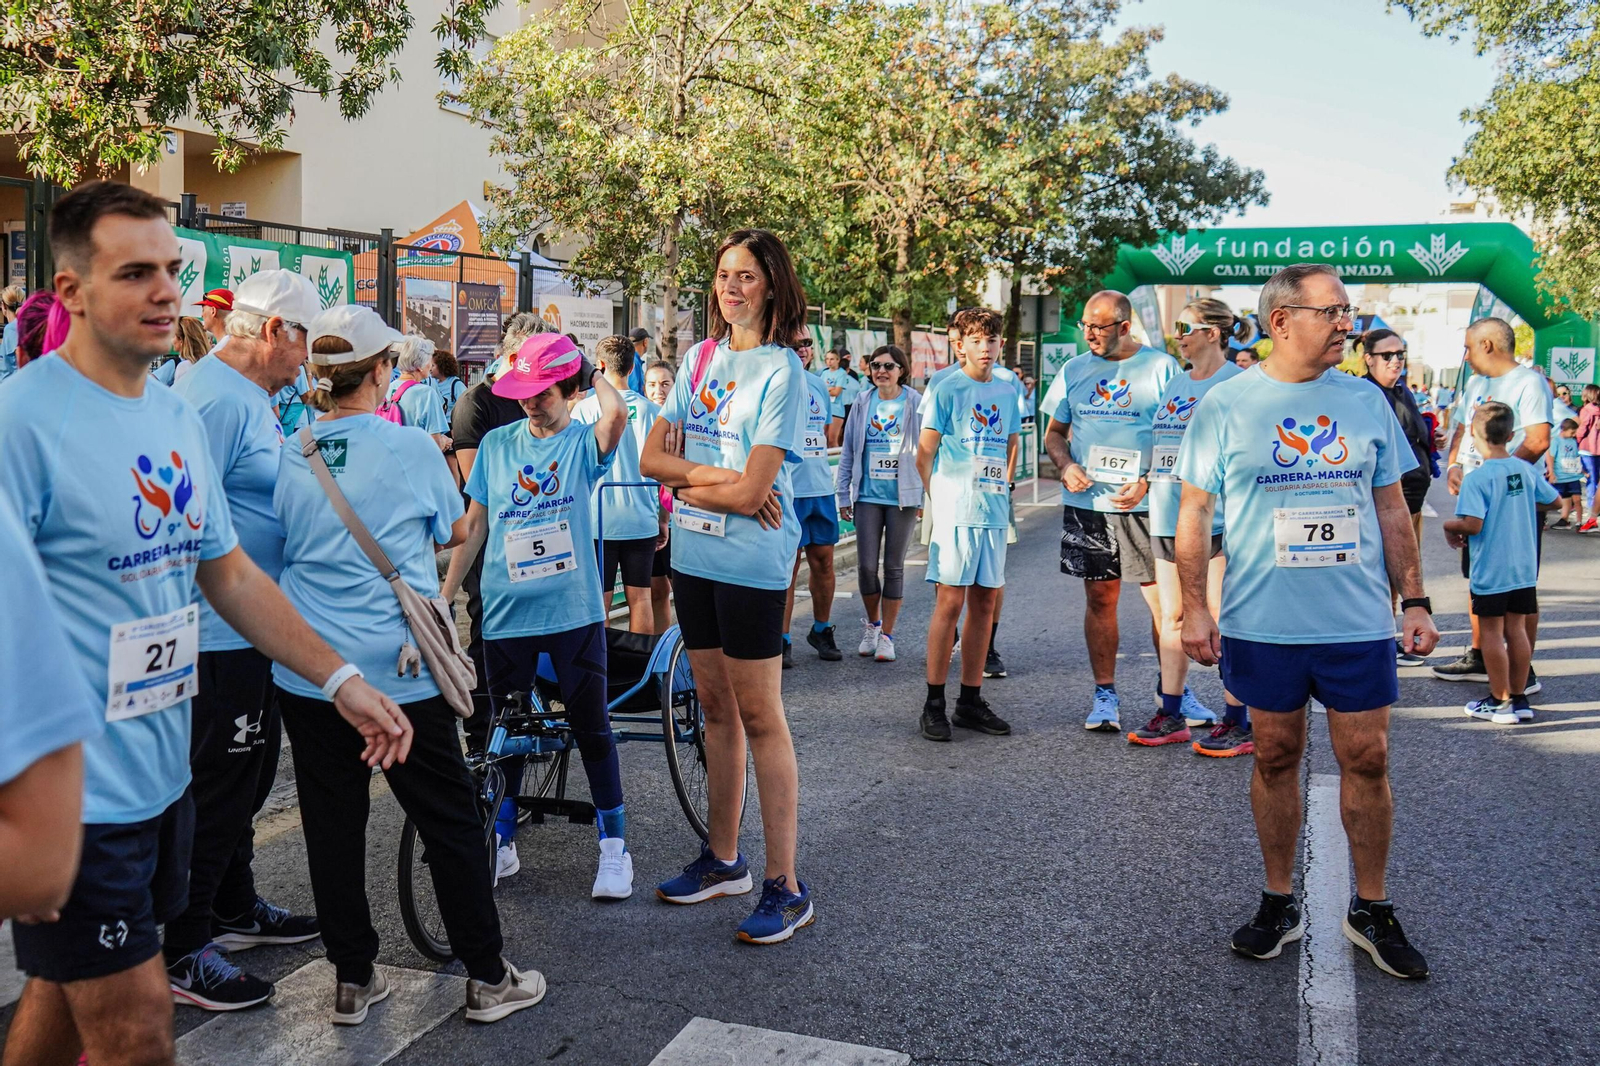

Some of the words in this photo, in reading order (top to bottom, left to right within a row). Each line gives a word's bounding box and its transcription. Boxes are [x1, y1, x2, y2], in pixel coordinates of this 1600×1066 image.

[1214, 236, 1396, 258] fundación
[221, 247, 231, 287] ación
[1213, 264, 1251, 276] CAJA
[1254, 264, 1283, 276] RUR
[1339, 264, 1394, 276] ANADA
[468, 297, 498, 311] OMEGA
[570, 320, 590, 328] HACEMOS
[596, 320, 608, 329] SUEÑO
[878, 459, 899, 469] 192
[1101, 456, 1128, 469] 167
[983, 465, 1002, 478] 168
[1256, 470, 1363, 484] CARRERA-MARCHA
[498, 495, 574, 518] CARRE-MARCHA
[1303, 523, 1335, 542] 78
[533, 540, 545, 556] 5
[145, 638, 177, 674] 27
